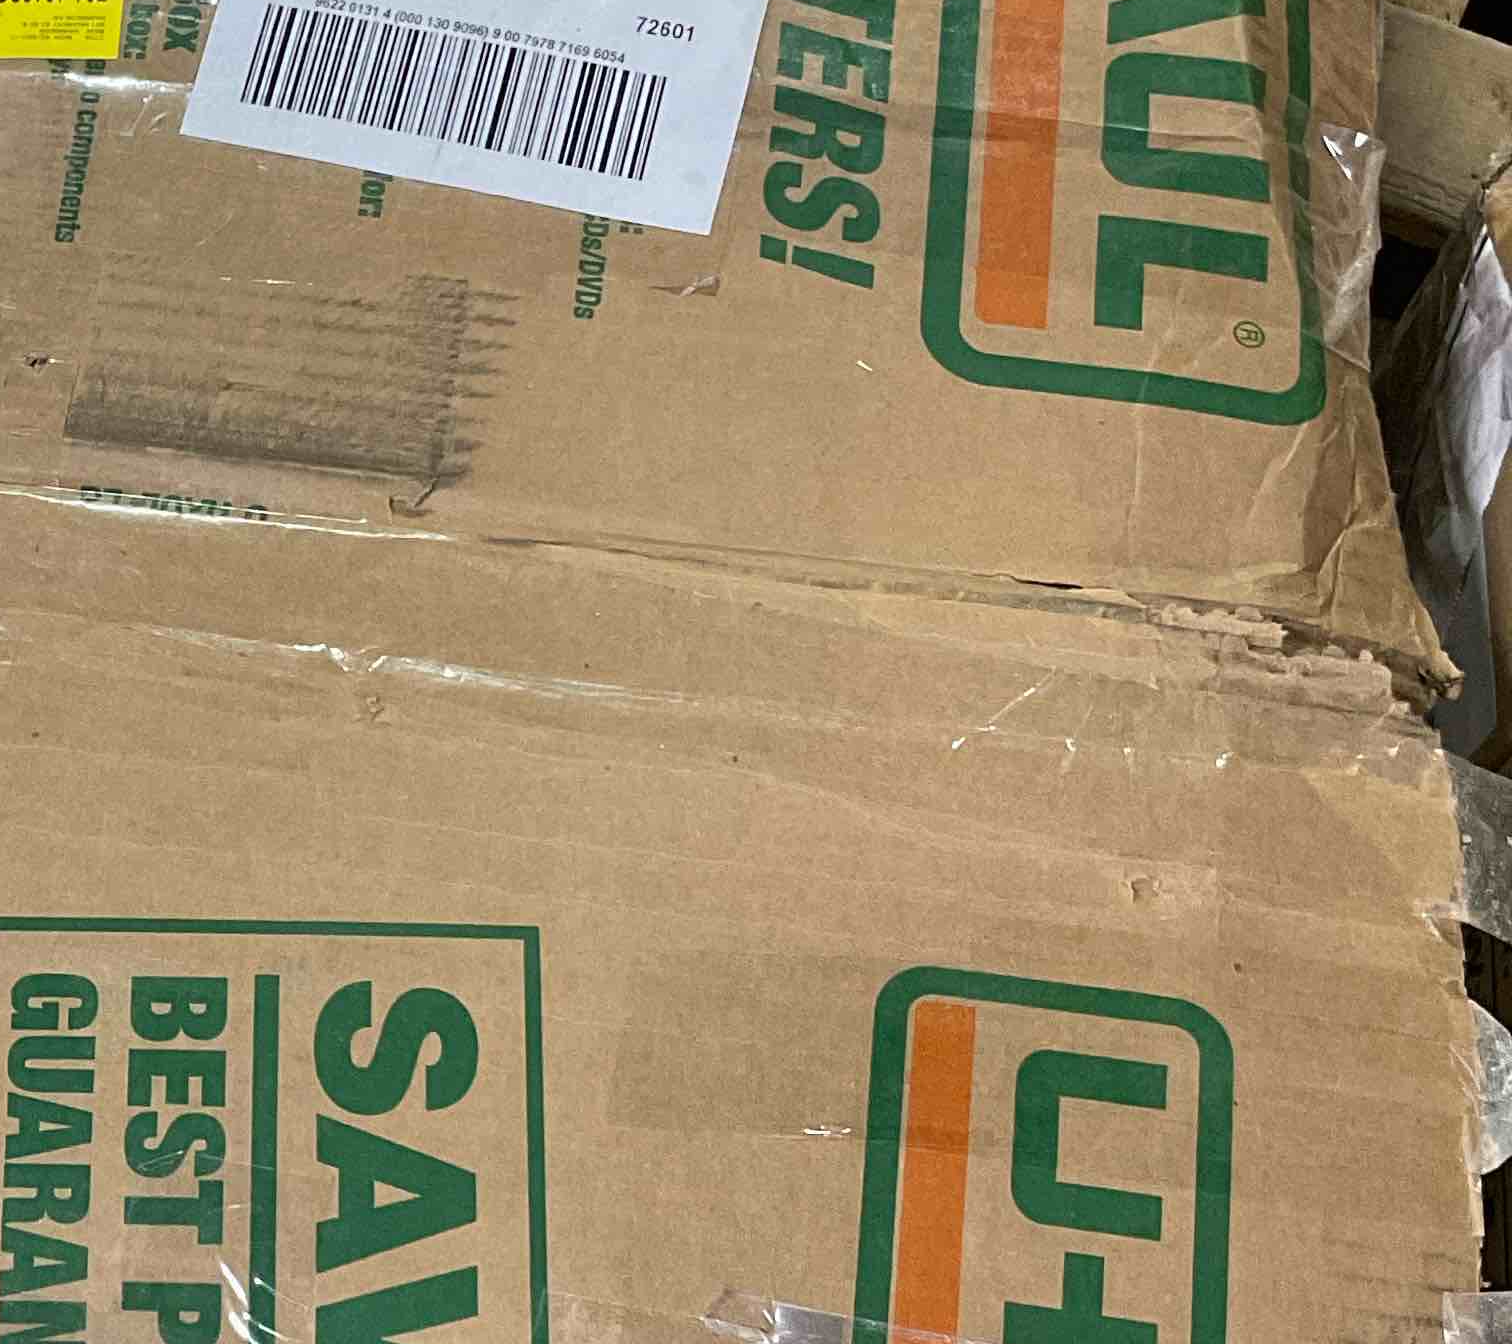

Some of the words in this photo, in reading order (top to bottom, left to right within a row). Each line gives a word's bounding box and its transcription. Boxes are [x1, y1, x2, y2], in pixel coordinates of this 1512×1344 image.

[427, 16, 450, 31] 130
[594, 47, 626, 64] 6054
[635, 16, 695, 42] 72601
[55, 110, 99, 242] components
[122, 973, 229, 1246] BEST
